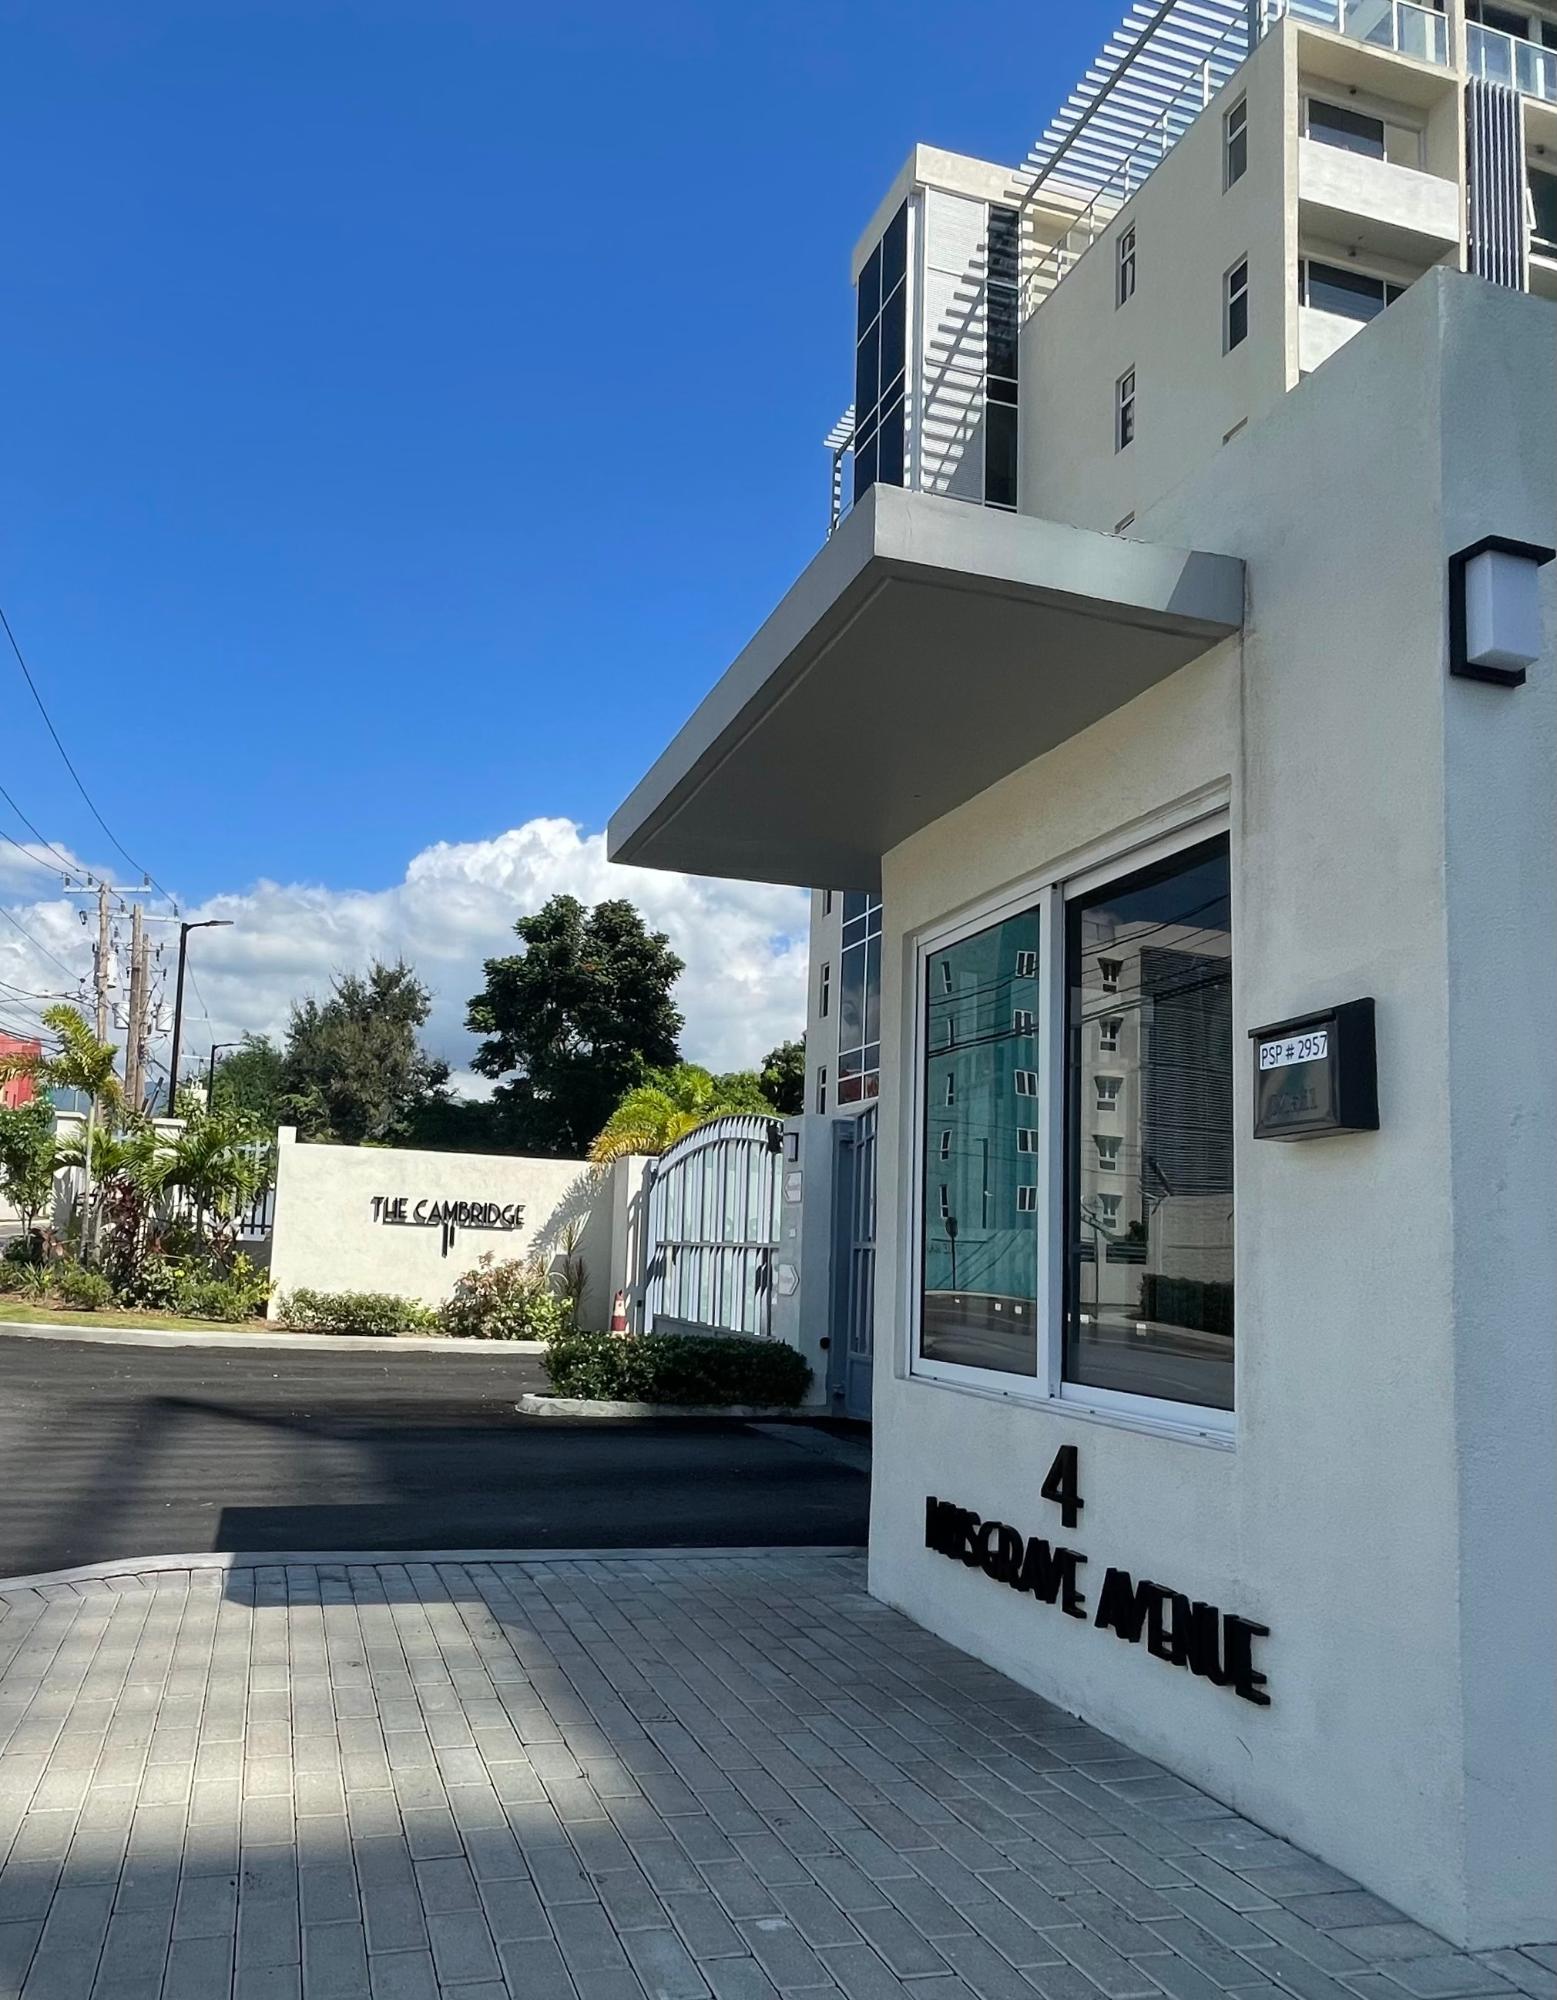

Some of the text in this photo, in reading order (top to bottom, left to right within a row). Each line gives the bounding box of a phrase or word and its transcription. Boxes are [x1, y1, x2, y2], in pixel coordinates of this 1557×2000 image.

[1261, 1034, 1327, 1067] PSP # 2957
[371, 1196, 526, 1229] THE CAMBRIDGE
[1041, 1444, 1084, 1528] 4
[1094, 1567, 1271, 1705] AVENUE
